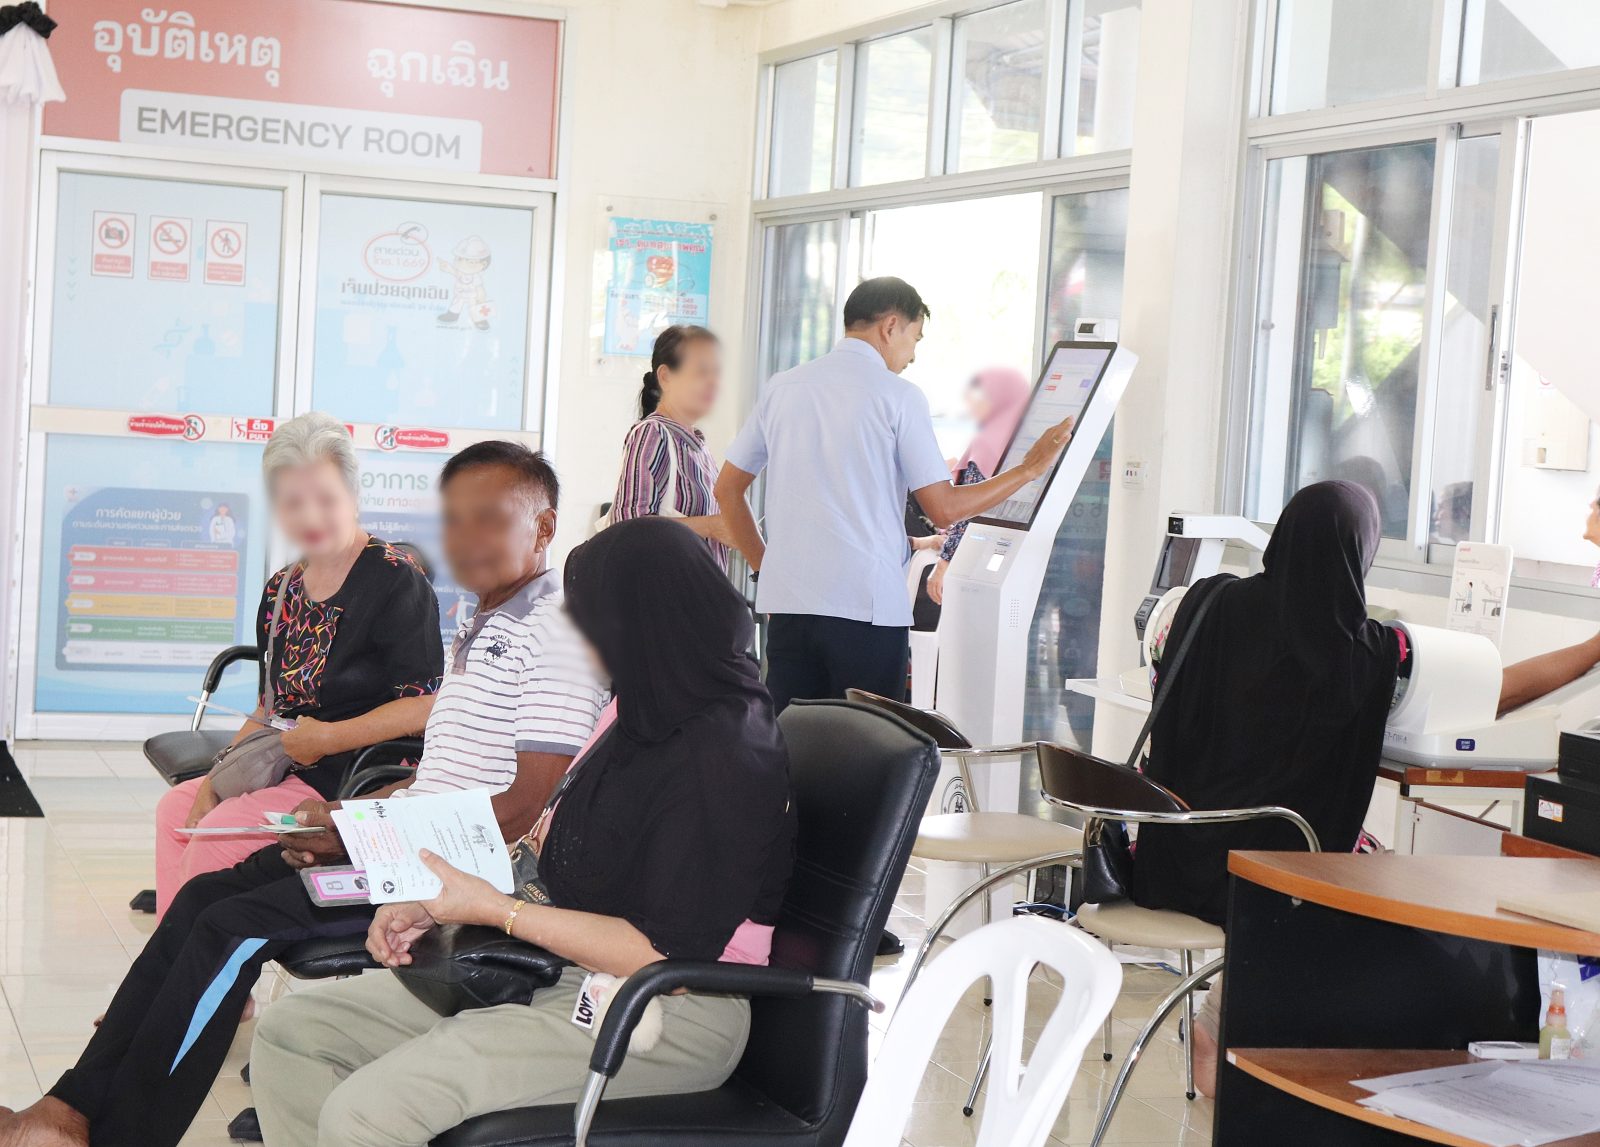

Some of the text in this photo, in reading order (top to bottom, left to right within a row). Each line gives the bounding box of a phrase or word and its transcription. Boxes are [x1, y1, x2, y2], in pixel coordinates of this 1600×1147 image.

[93, 8, 510, 98] อุบัติเหตุ ฉุกเฉิน
[136, 106, 461, 160] EMERGENCY ROOM
[361, 471, 429, 490] อาการ
